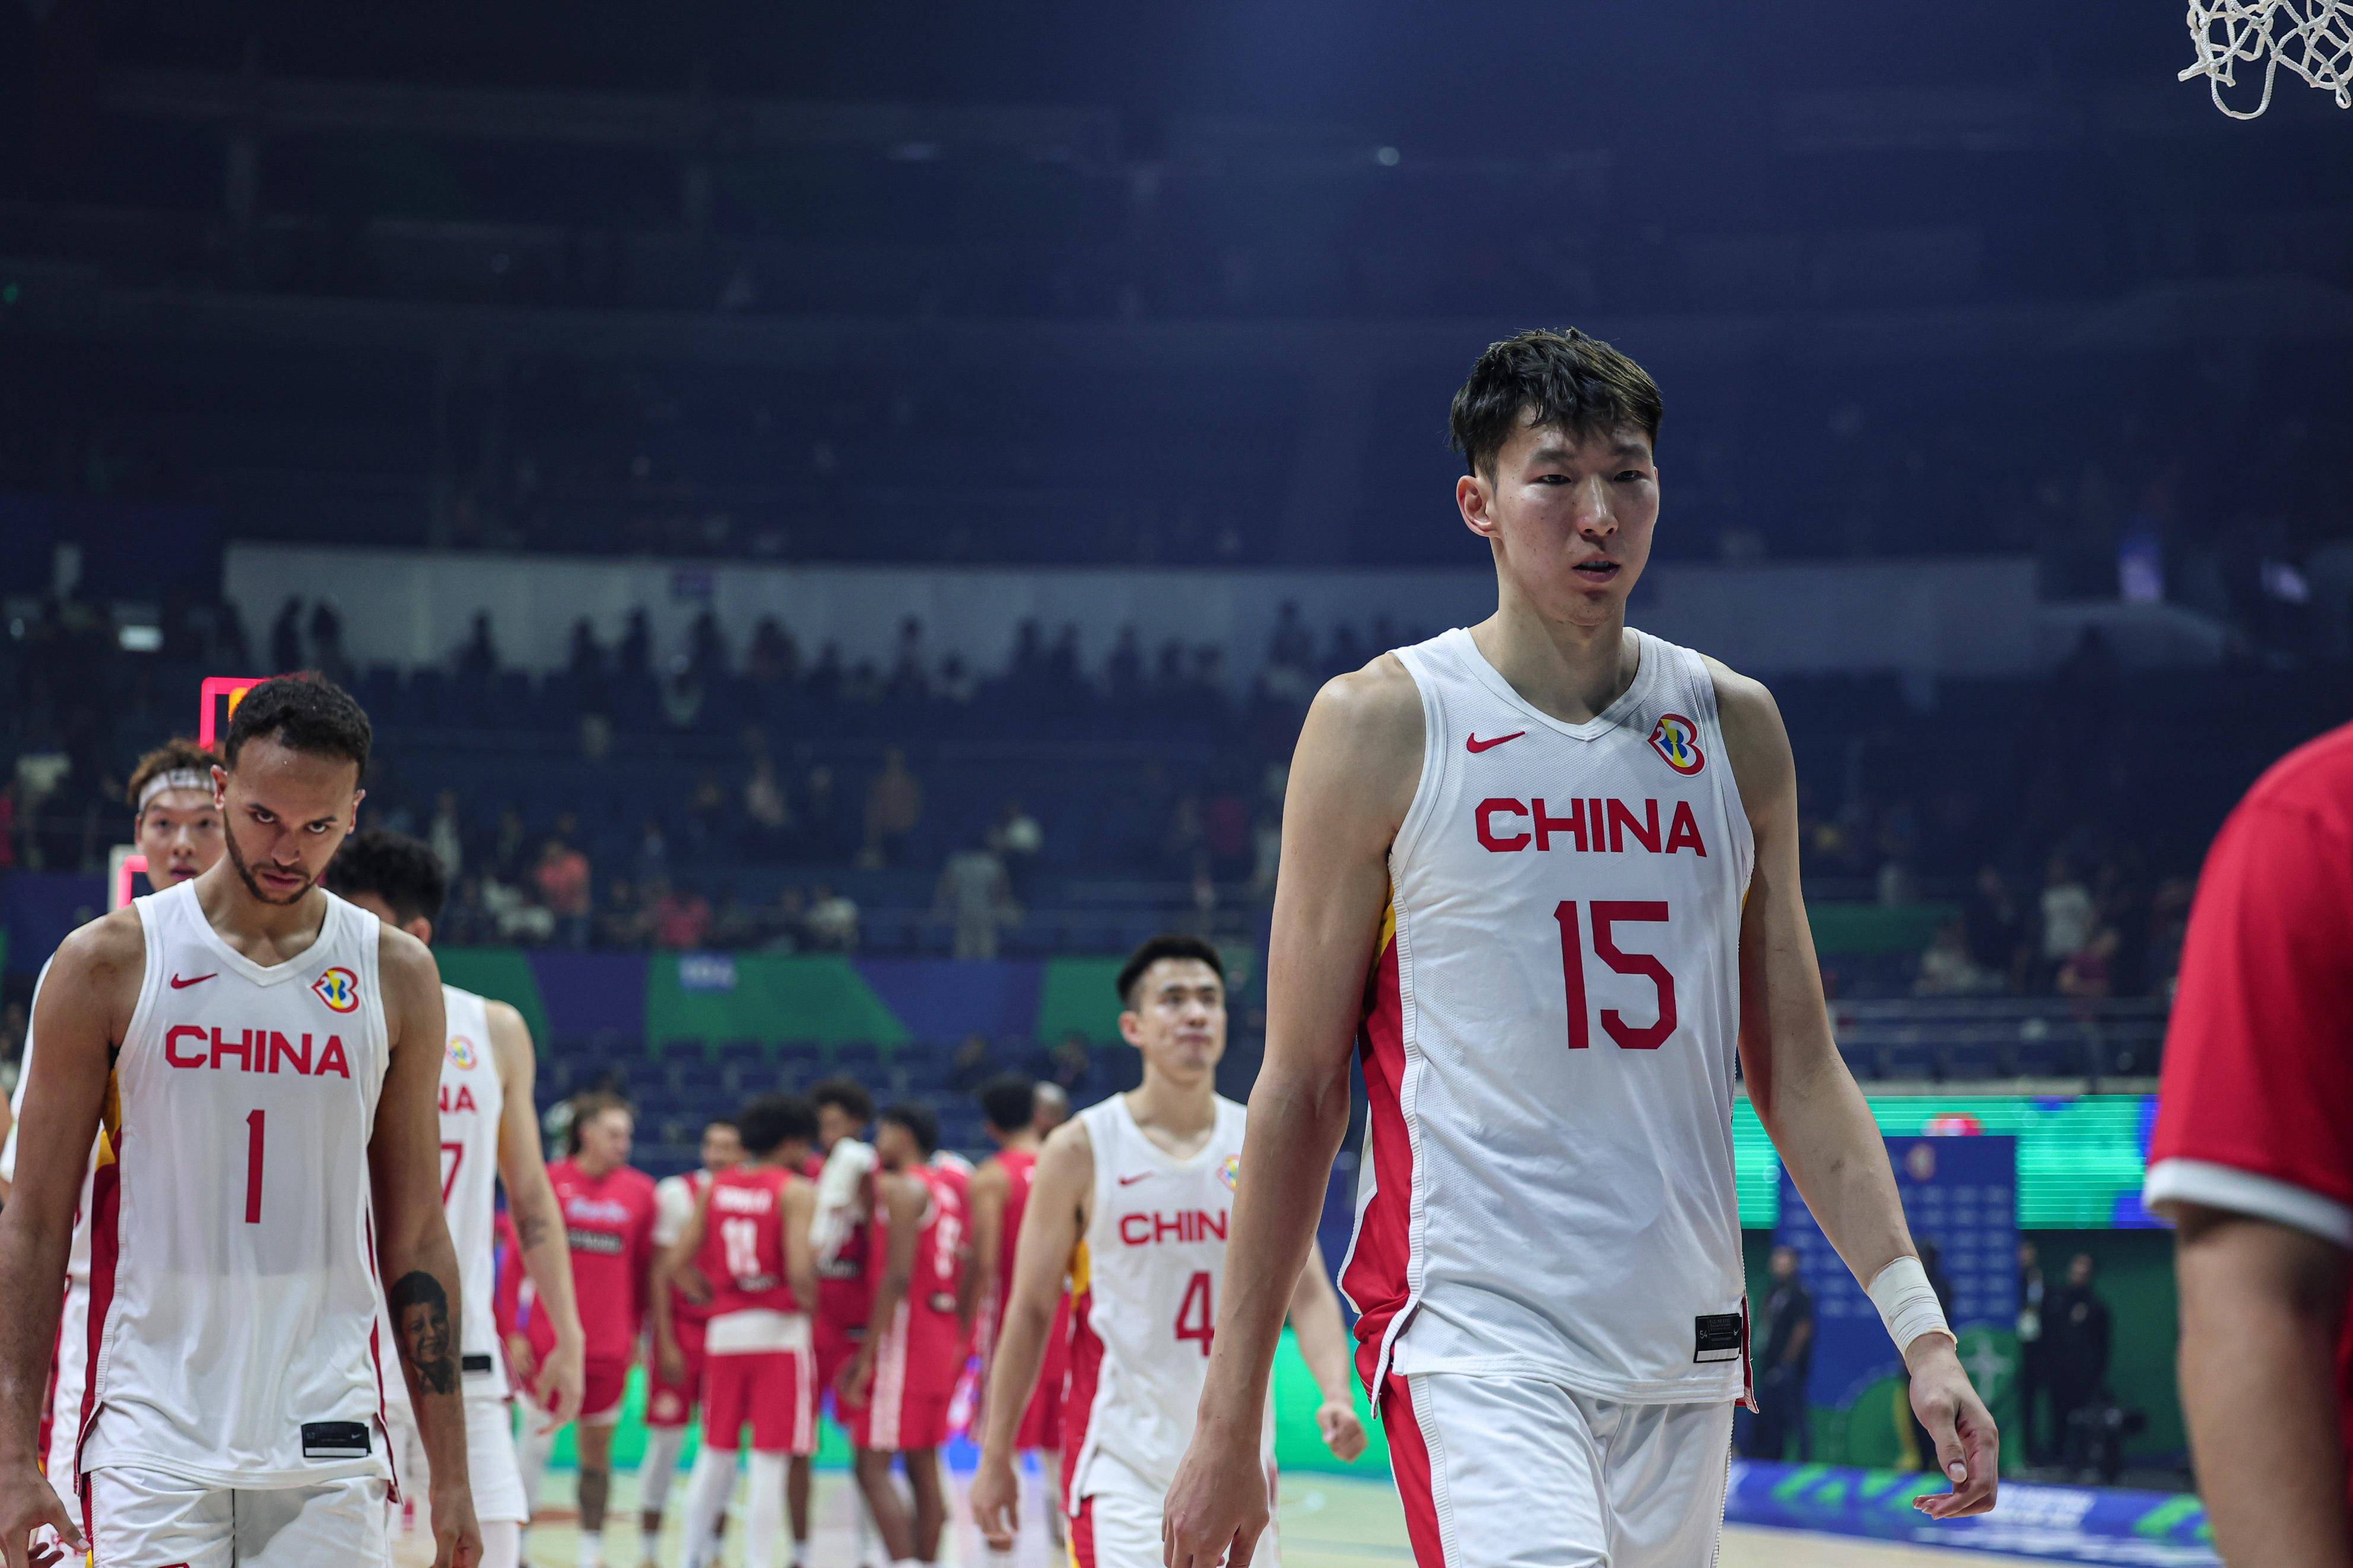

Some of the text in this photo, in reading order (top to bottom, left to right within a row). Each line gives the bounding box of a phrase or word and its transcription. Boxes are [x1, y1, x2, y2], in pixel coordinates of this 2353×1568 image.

[1475, 798, 1706, 857] CHINA
[1555, 901, 1677, 1049] 15
[165, 1025, 351, 1079] CHINA
[245, 1109, 265, 1224] 1
[1118, 1210, 1228, 1247] CHIN
[1174, 1271, 1215, 1357] 4
